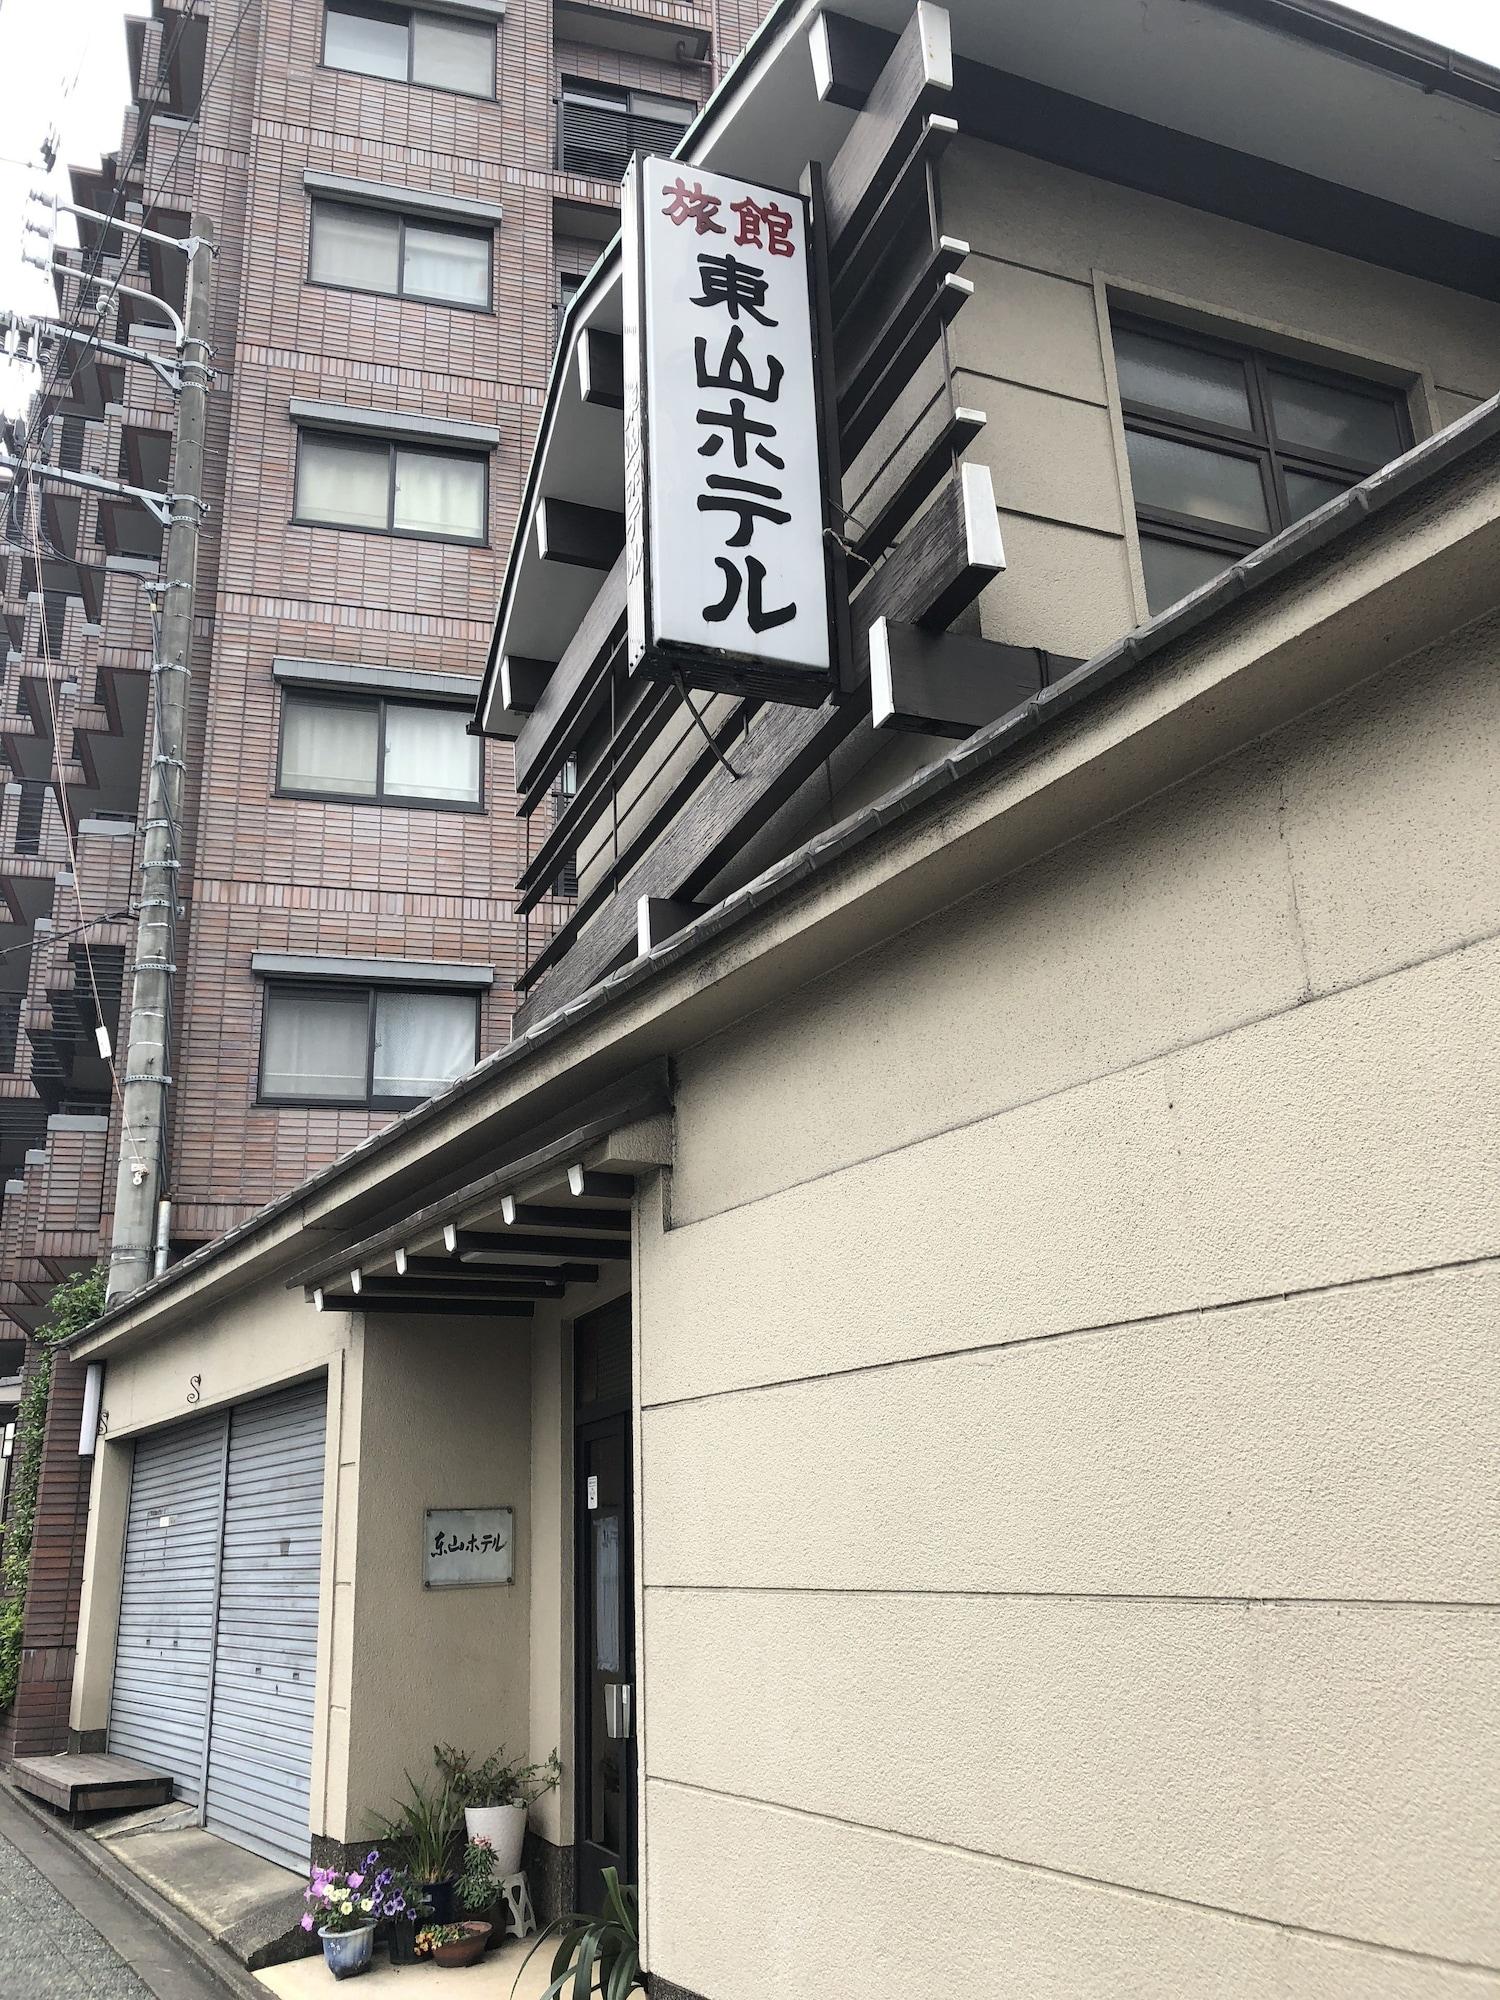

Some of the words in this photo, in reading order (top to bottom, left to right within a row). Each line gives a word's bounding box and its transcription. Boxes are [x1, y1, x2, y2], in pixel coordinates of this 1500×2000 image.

[661, 177, 796, 258] 旅館
[688, 252, 797, 634] 東山ホテル
